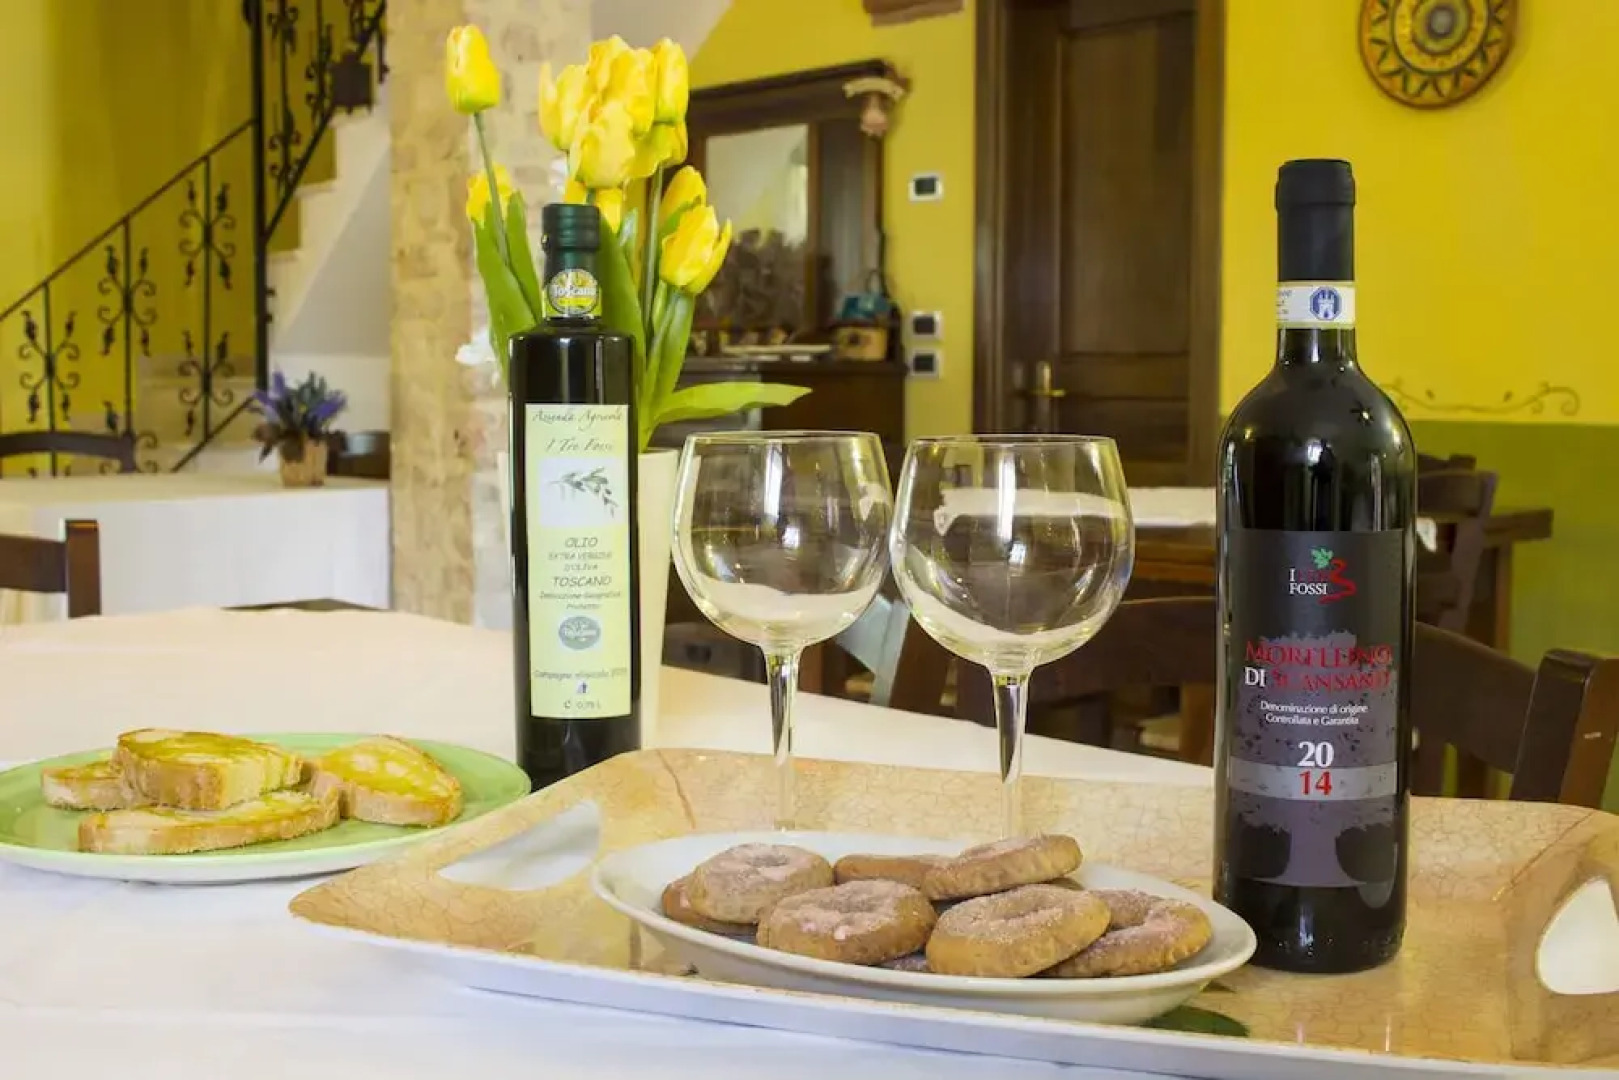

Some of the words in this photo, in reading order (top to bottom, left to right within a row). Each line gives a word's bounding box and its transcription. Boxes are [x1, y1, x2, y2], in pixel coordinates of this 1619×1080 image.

[565, 537, 598, 548] OLIO
[553, 575, 613, 588] TOSCANO
[1289, 567, 1296, 582] I
[1289, 582, 1328, 595] FOSSI
[1245, 640, 1395, 668] MORELLINO
[1244, 666, 1267, 688] DI
[1271, 667, 1391, 692] SCANSANO
[1260, 700, 1328, 714] Denominazione
[1329, 703, 1338, 714] di
[1339, 704, 1369, 717] origine
[1265, 712, 1312, 725] Controllata
[1312, 717, 1320, 726] e
[1321, 715, 1360, 727] Garantita
[1297, 740, 1335, 768] 20
[1299, 770, 1333, 796] 14
